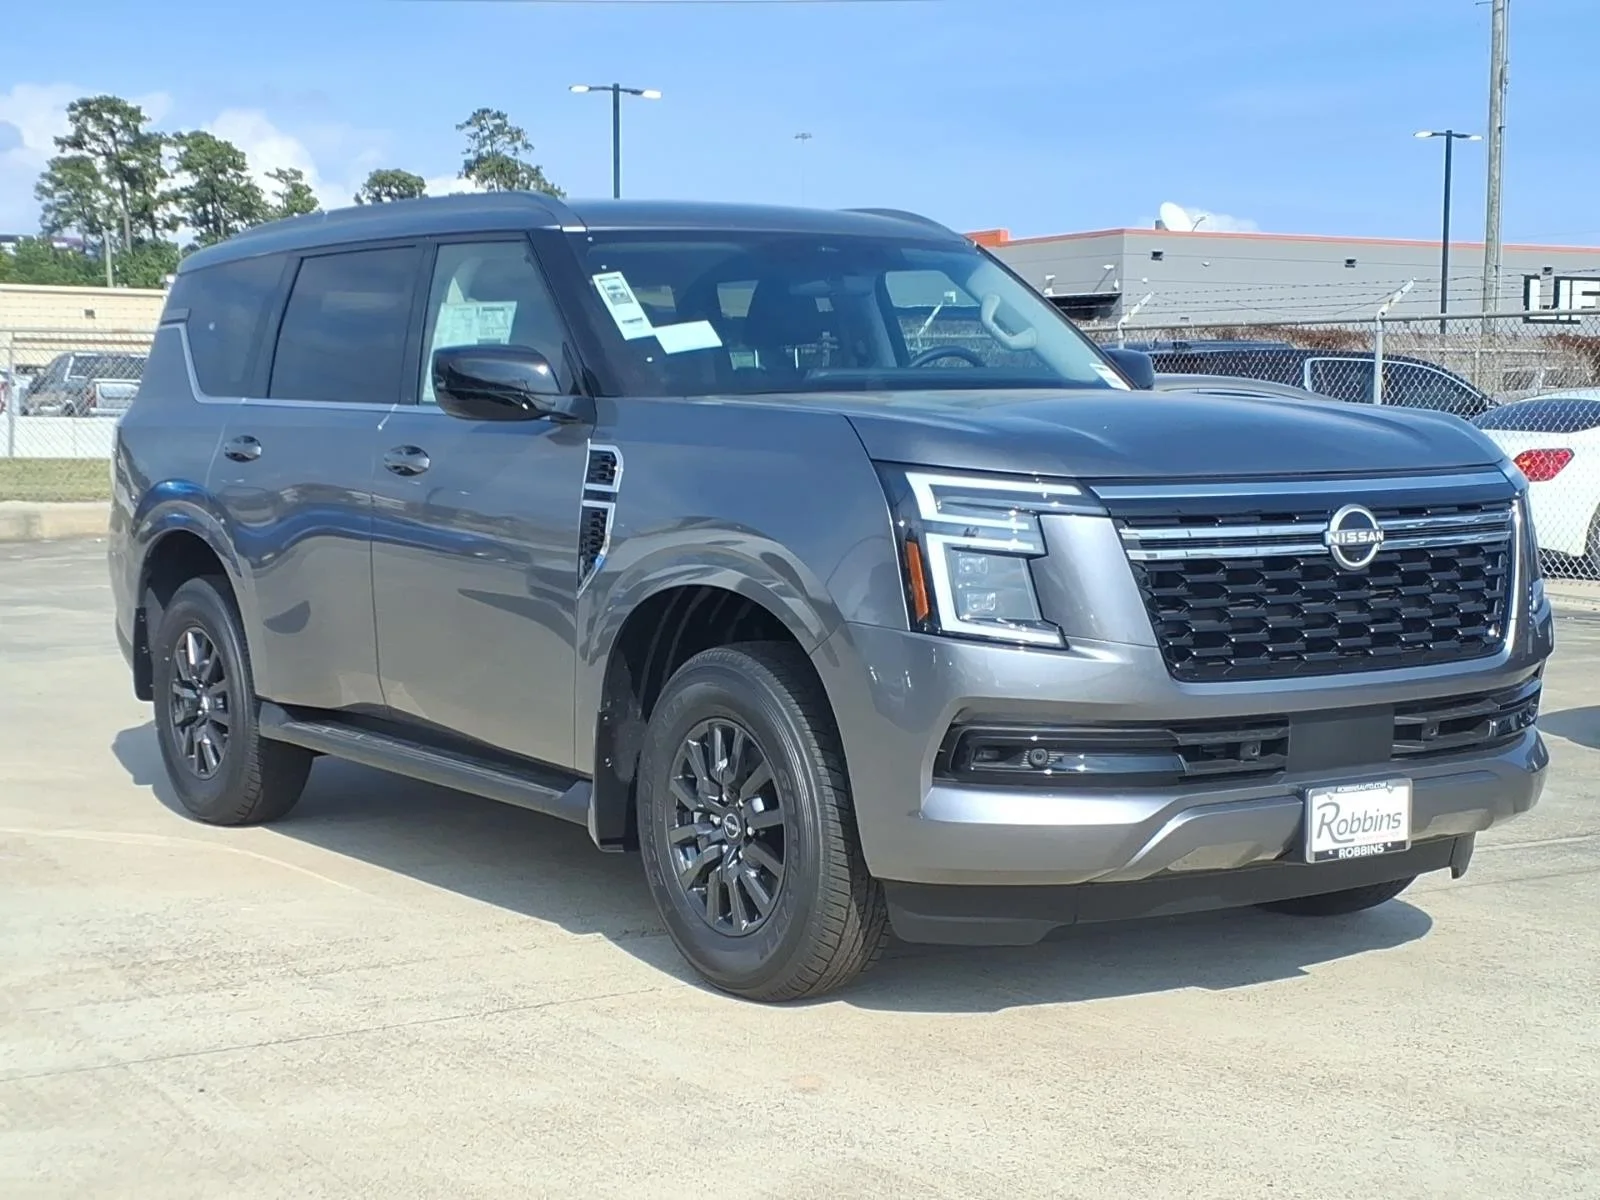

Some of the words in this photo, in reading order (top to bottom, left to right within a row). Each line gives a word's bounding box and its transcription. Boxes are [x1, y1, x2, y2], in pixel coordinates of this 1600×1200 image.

[1327, 530, 1384, 544] NISSAN
[1317, 801, 1402, 843] Robbins
[1338, 843, 1384, 859] ROBBINS
